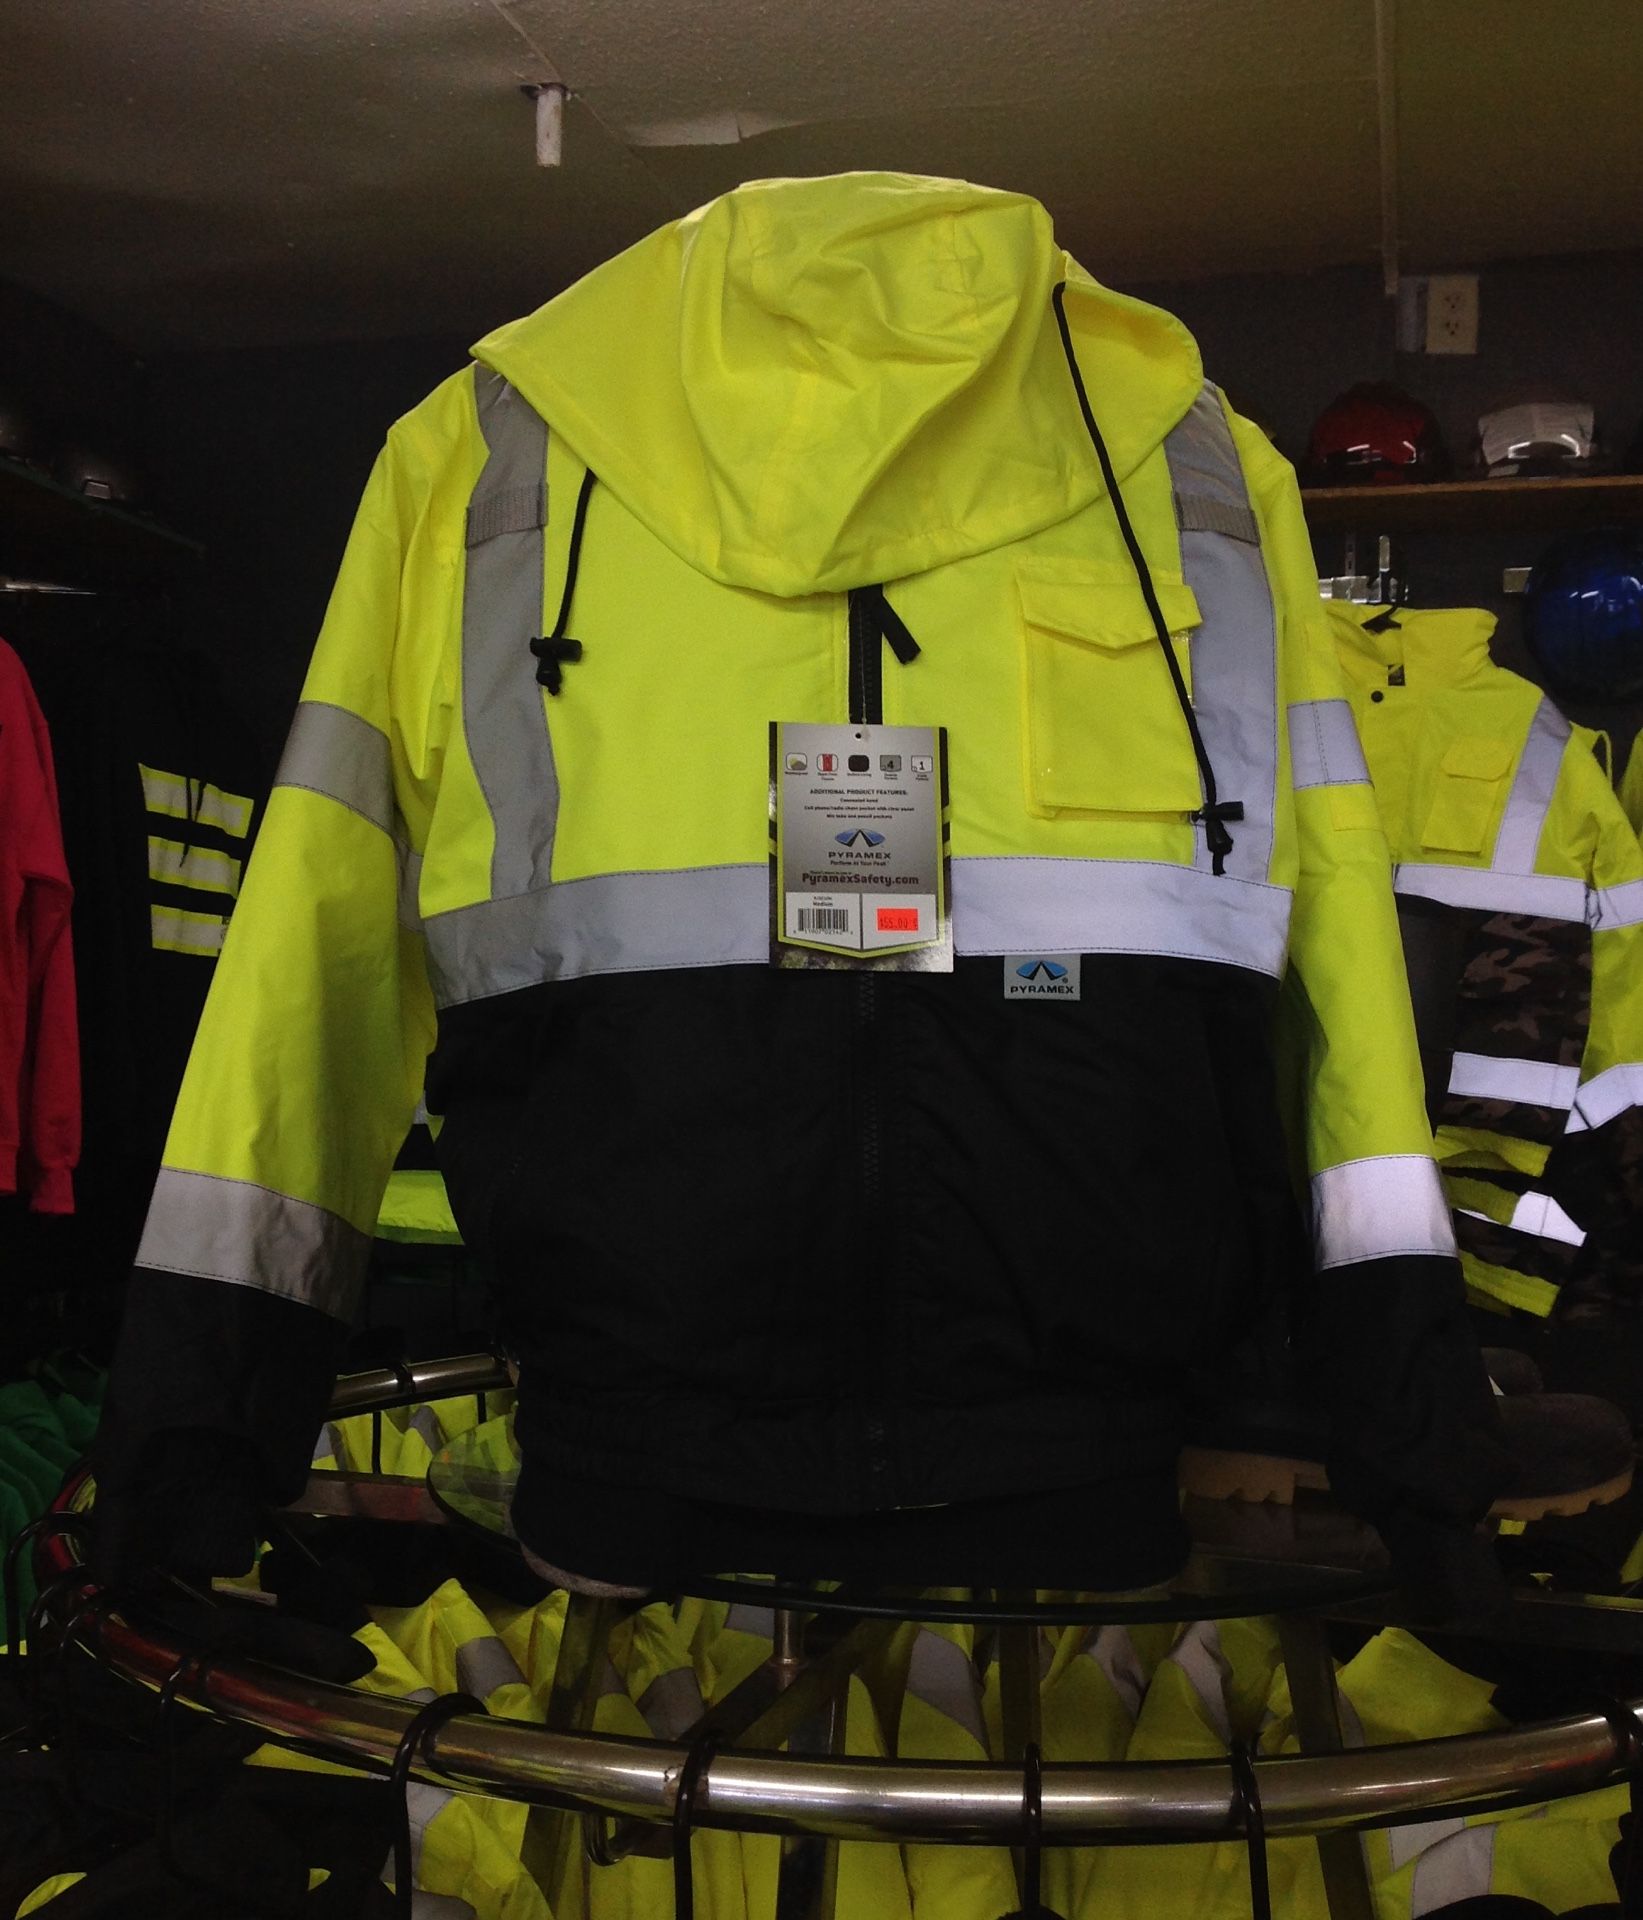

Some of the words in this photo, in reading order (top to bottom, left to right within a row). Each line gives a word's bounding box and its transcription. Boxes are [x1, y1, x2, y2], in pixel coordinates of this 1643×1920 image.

[828, 851, 892, 860] PYRAMEX
[801, 872, 920, 887] PyramexSafety.com
[1010, 985, 1075, 994] PYRAMEX
